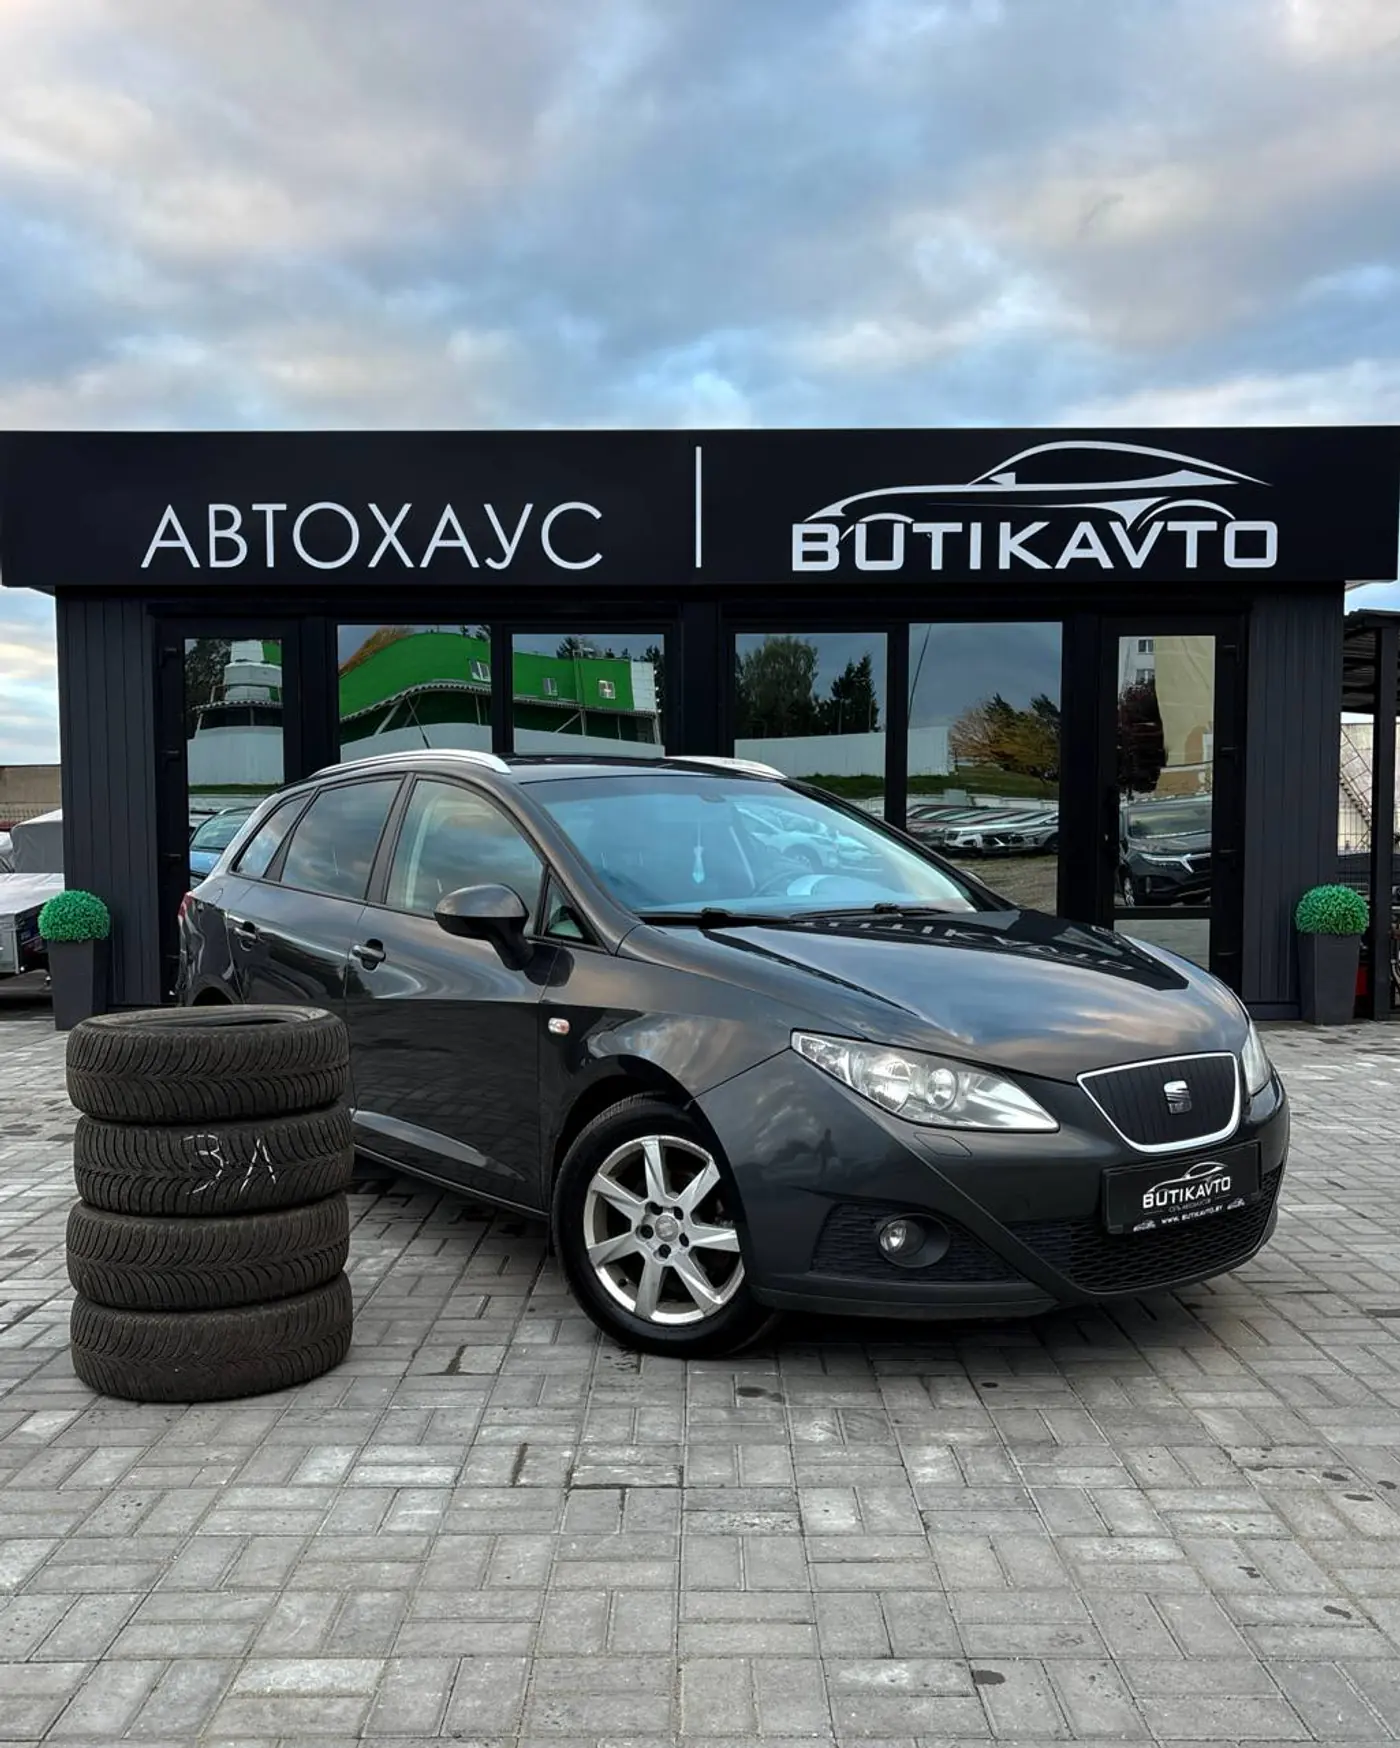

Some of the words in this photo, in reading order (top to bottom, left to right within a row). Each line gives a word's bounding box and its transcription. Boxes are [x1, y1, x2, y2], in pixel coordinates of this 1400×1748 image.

[141, 502, 603, 570] АВТОХАУС
[791, 520, 1278, 572] BUTIKAVTO
[1143, 1176, 1231, 1209] BUTIKAVTO
